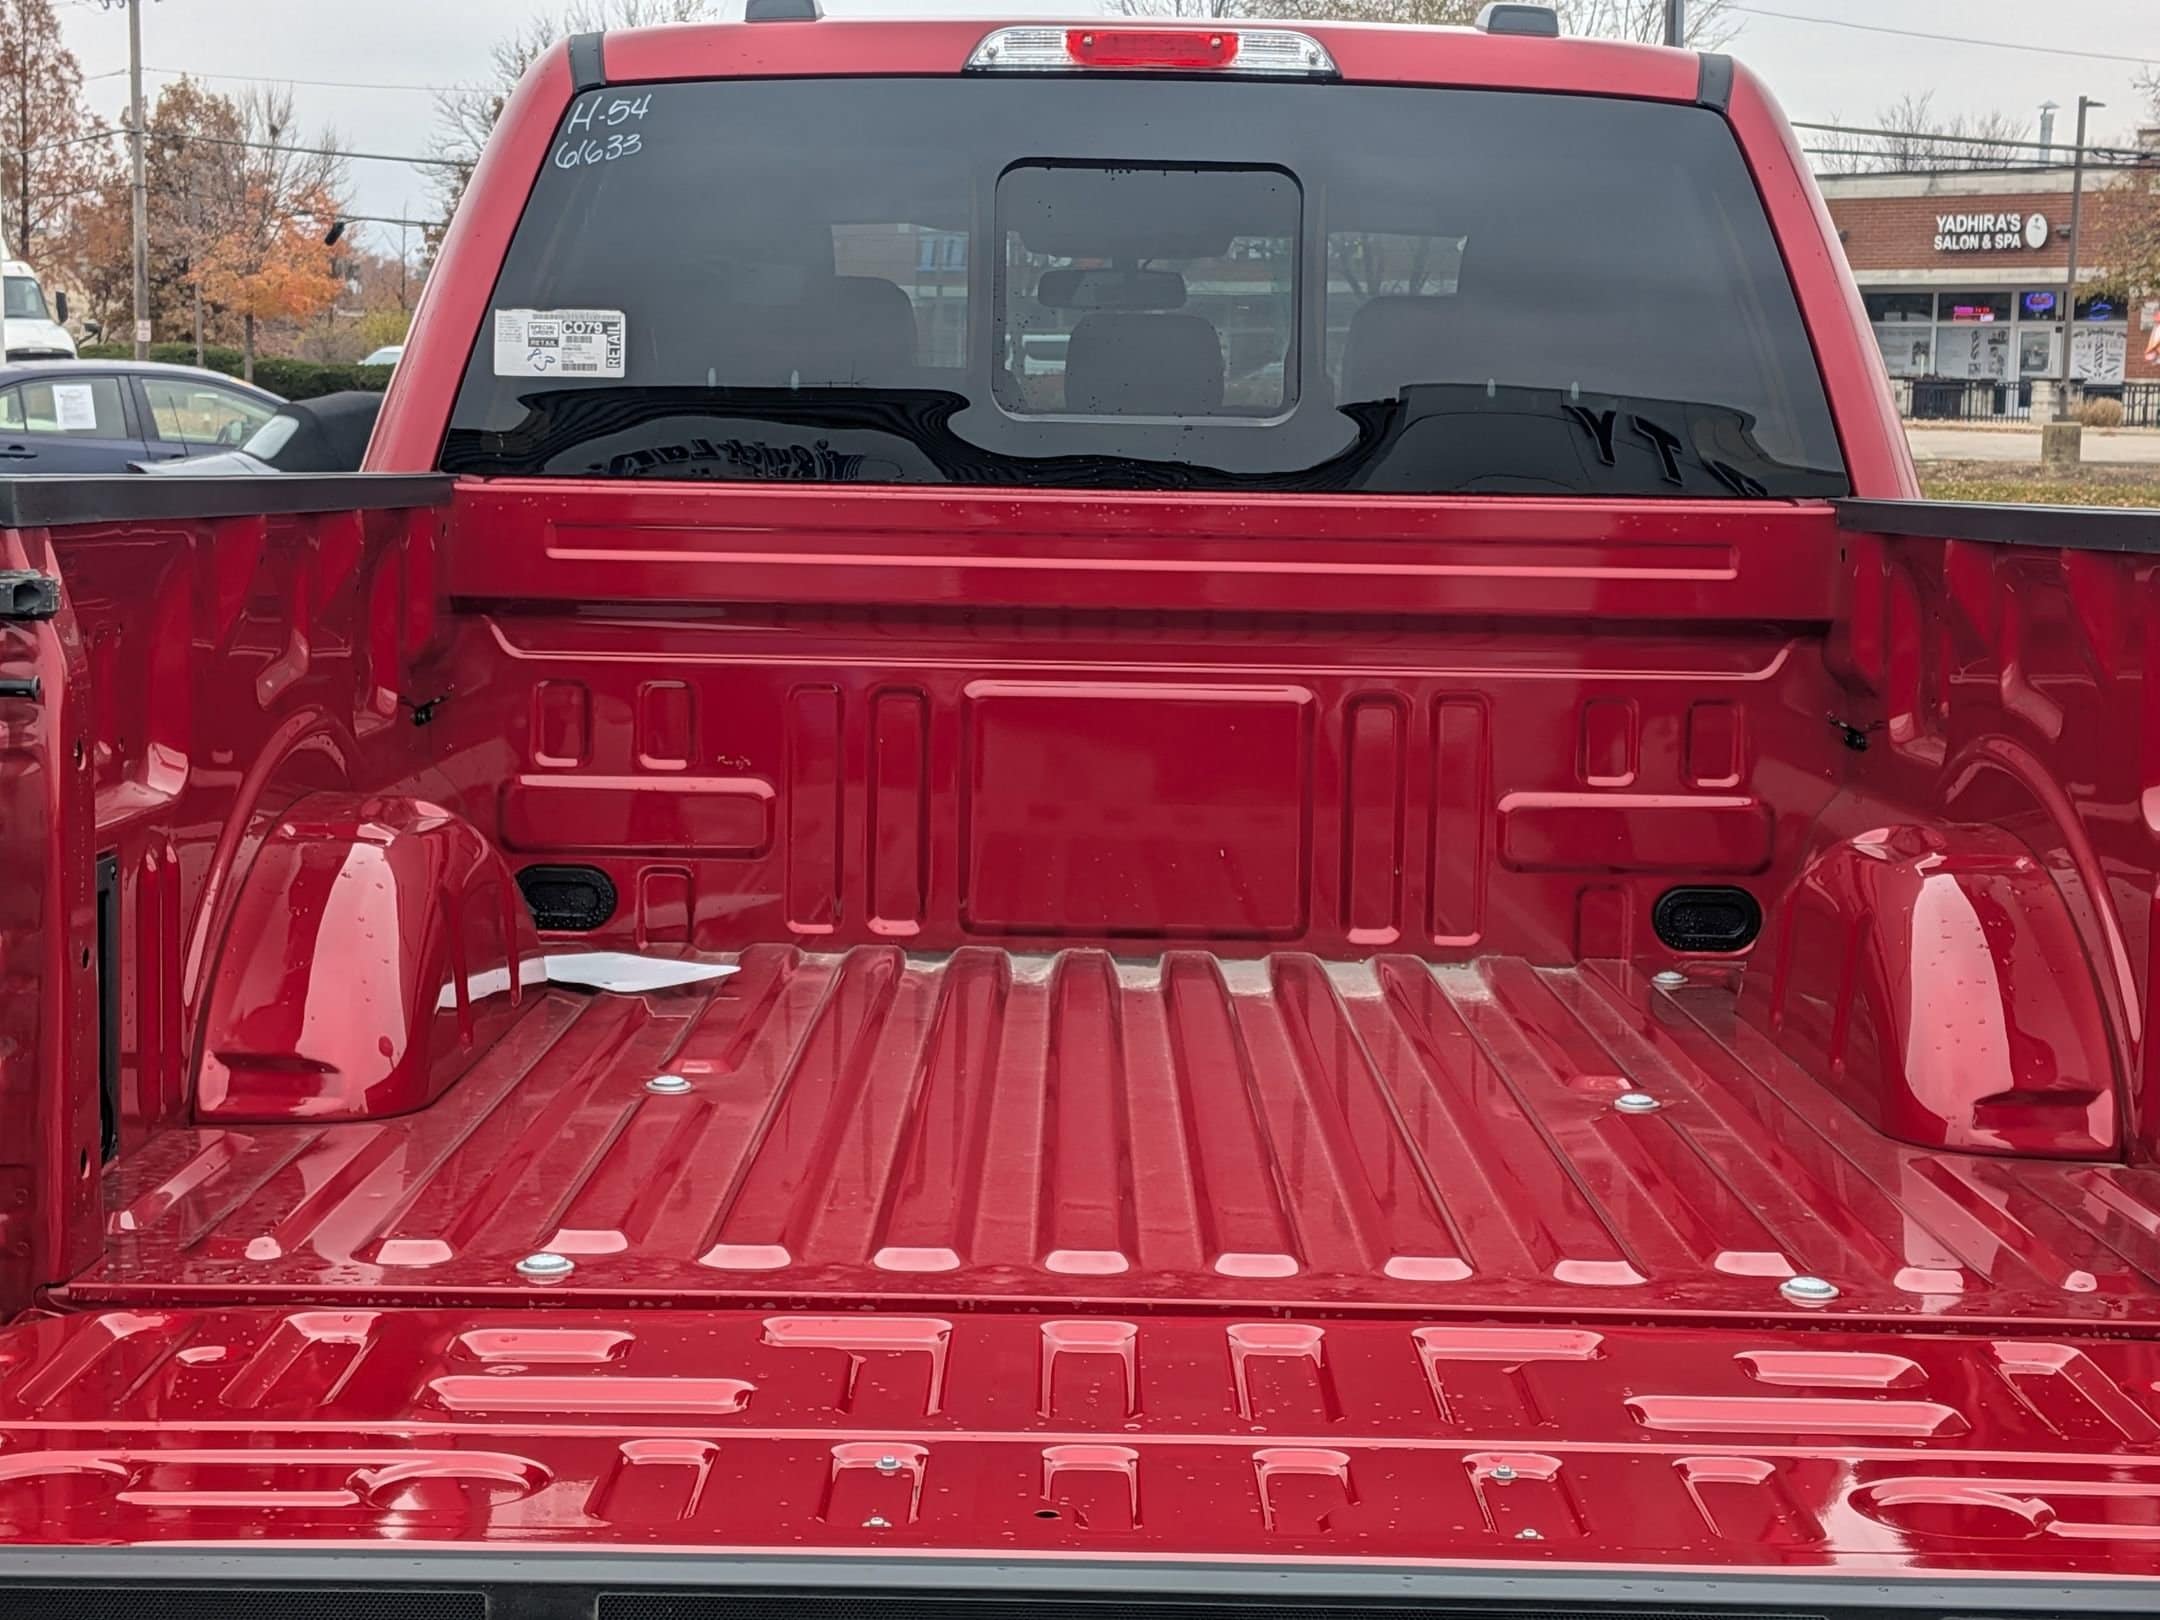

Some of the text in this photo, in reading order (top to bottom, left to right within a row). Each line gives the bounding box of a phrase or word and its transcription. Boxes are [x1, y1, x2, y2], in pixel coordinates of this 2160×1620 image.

[567, 93, 652, 135] H-54
[554, 133, 642, 169] 61633
[1935, 213, 2021, 233] YADHIRA'S
[1933, 233, 2021, 250] SALON & SPA
[607, 323, 620, 367] RETAIL
